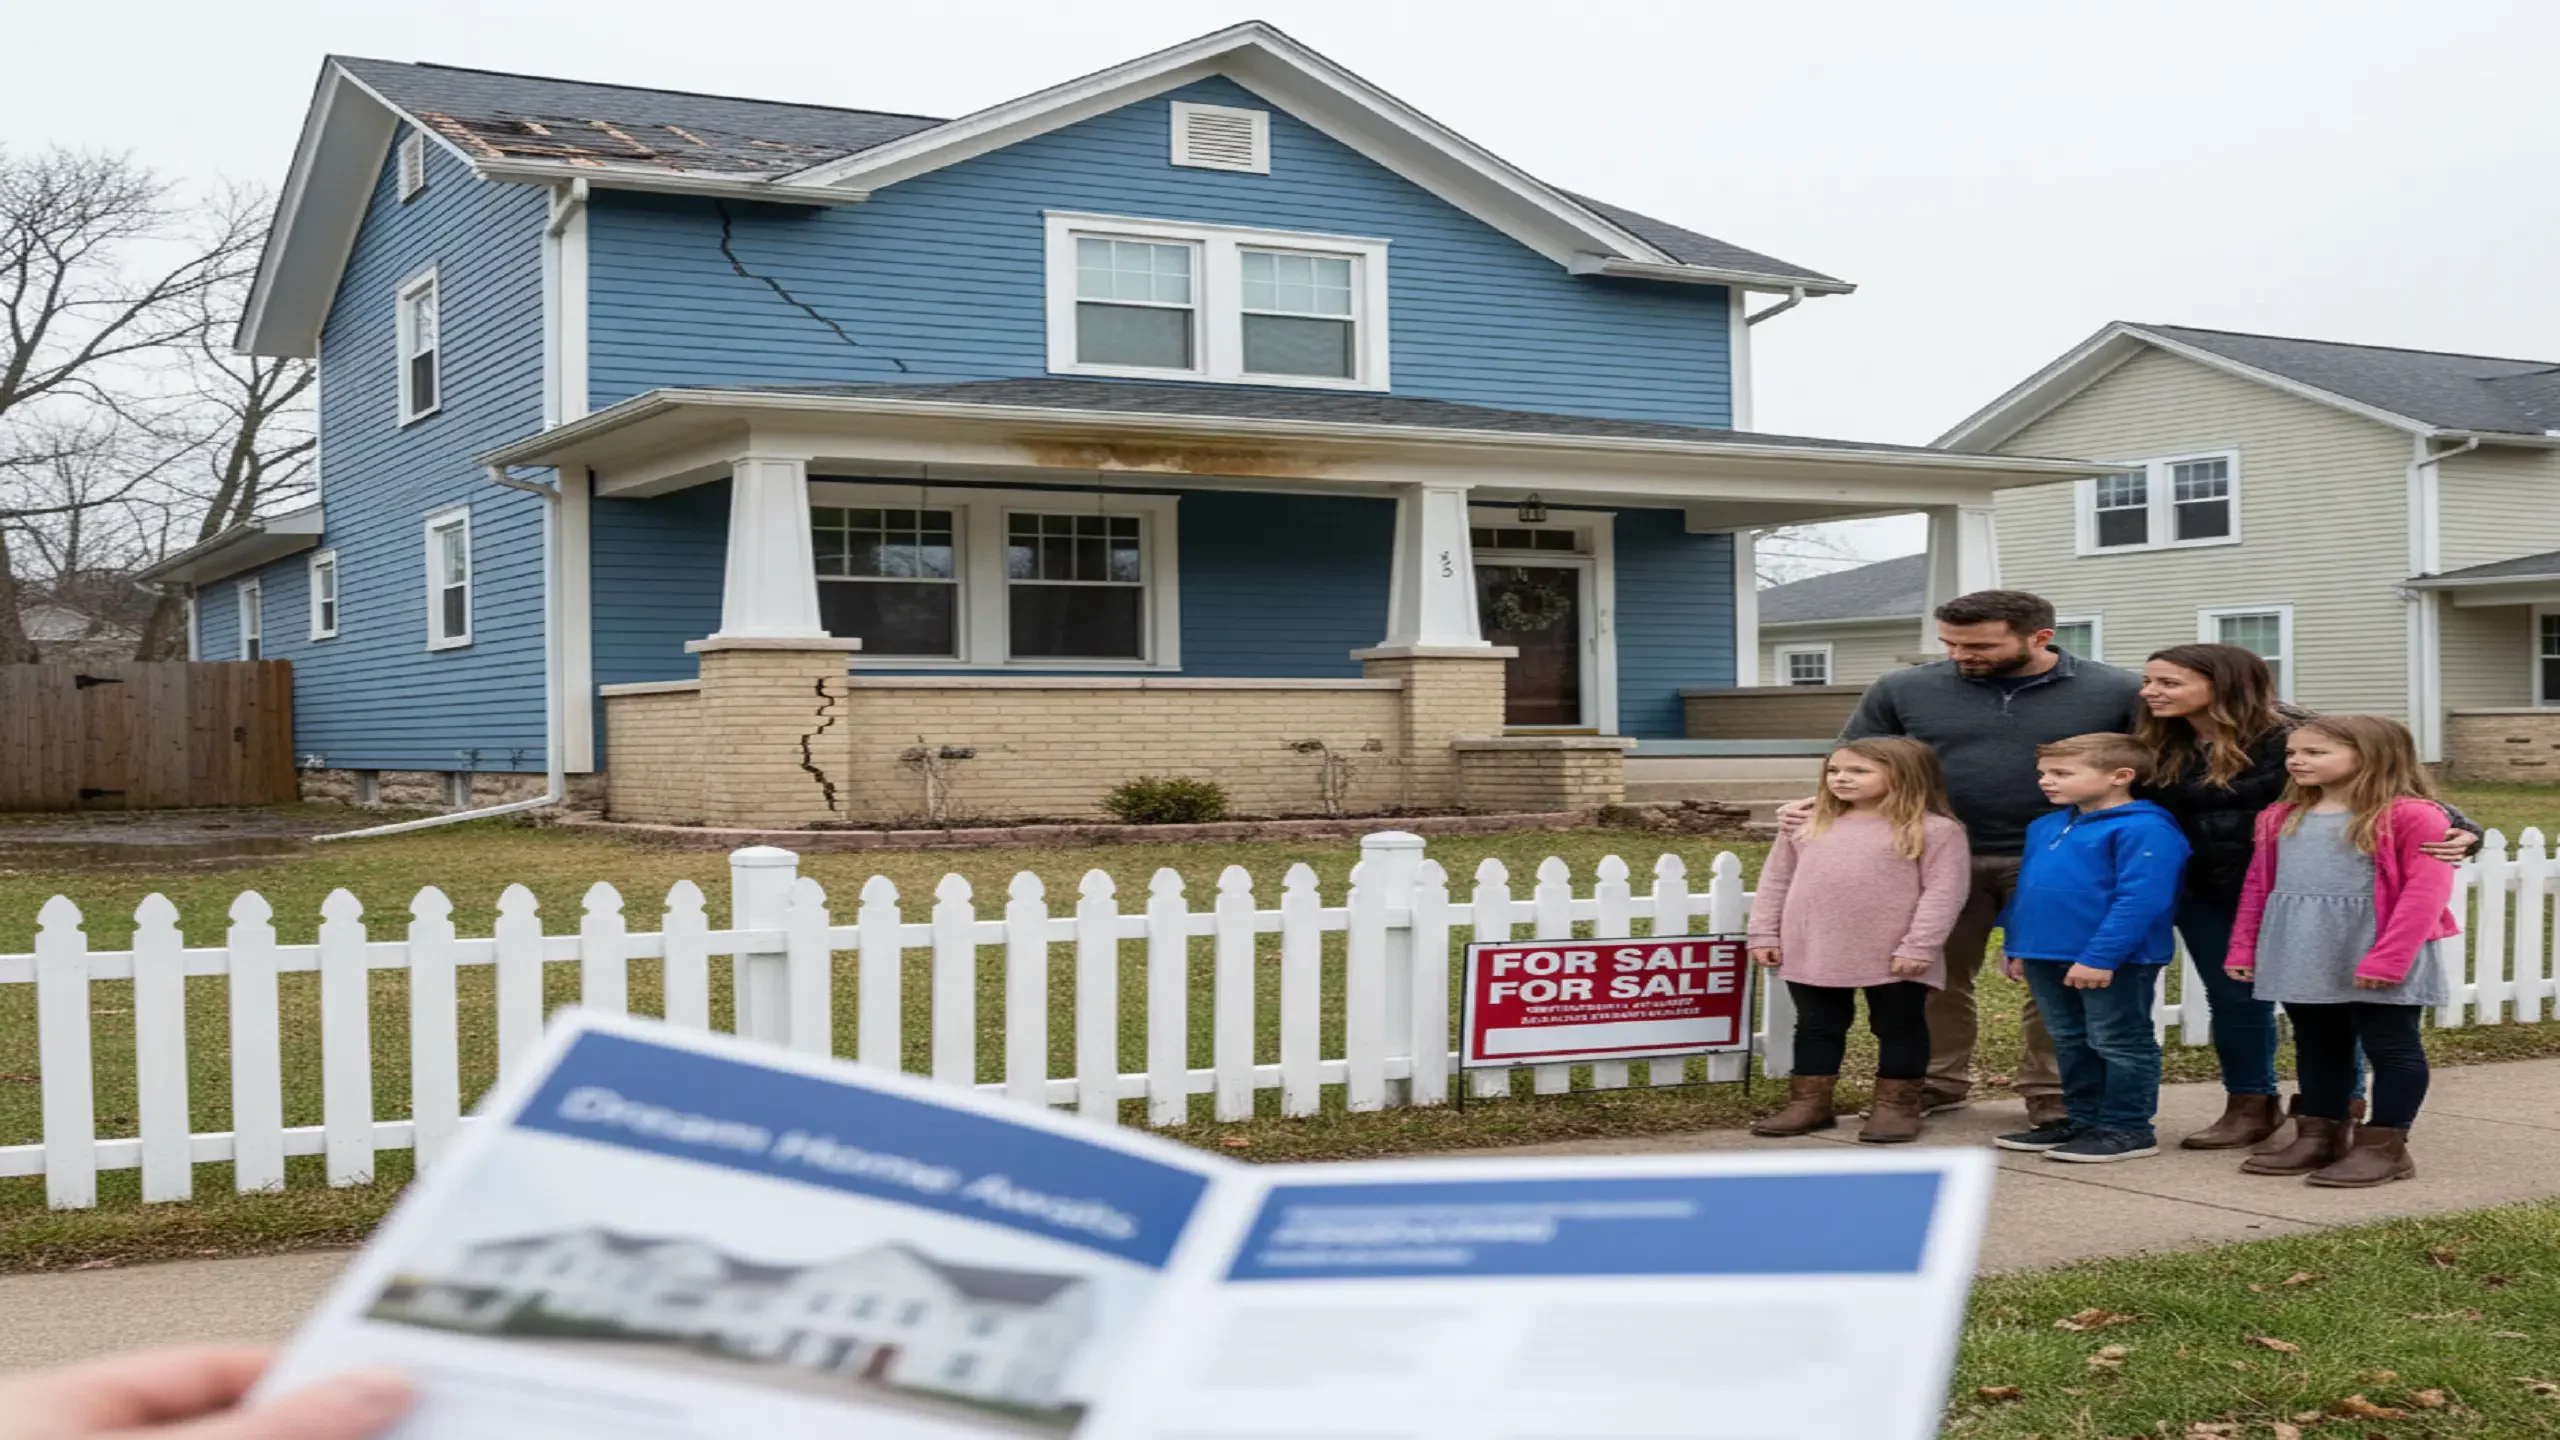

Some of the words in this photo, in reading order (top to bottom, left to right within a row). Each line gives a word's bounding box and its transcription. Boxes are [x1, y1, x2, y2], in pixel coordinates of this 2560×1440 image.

[1491, 951, 1598, 977] FOR
[1613, 945, 1737, 973] SALE
[1488, 978, 1593, 1004] FOR
[1608, 971, 1736, 999] SALE
